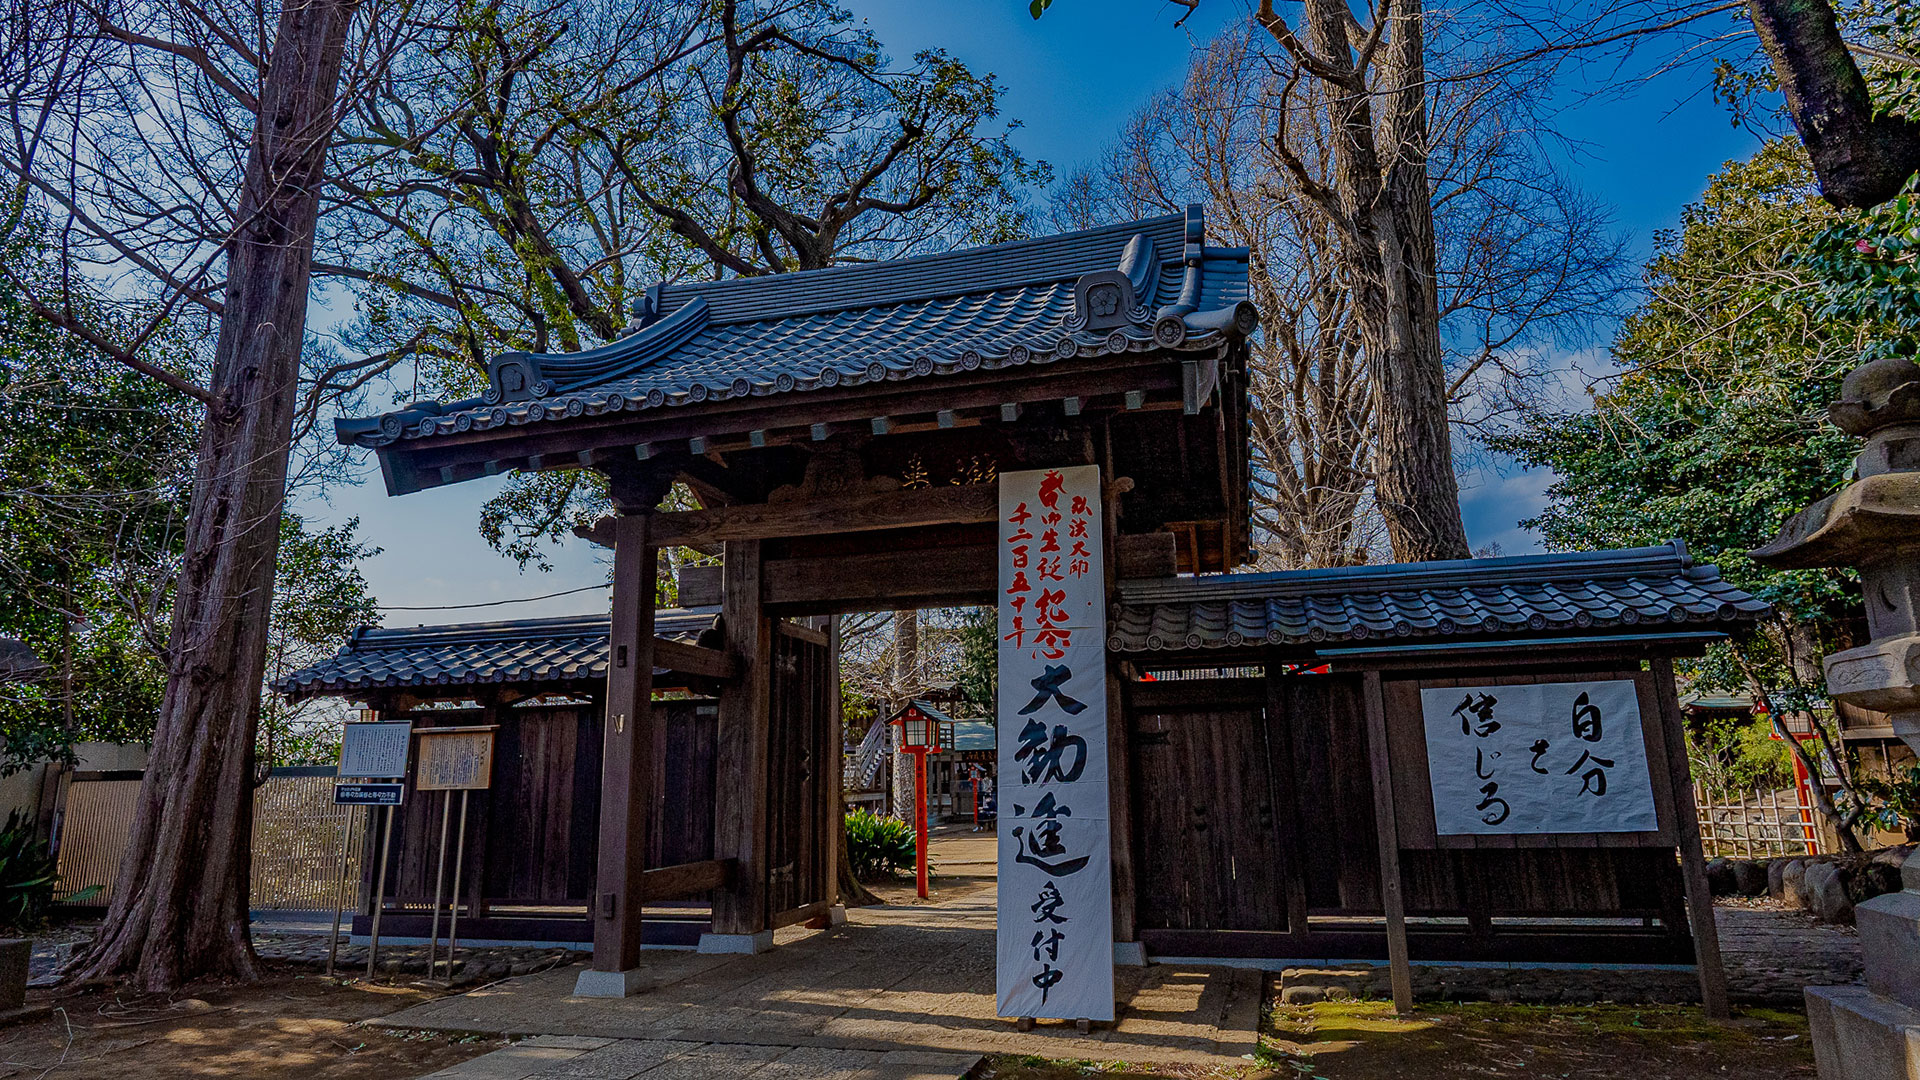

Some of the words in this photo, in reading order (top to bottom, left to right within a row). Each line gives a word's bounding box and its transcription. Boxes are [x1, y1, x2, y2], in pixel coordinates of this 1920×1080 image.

[1003, 502, 1033, 650] 千二百五十年
[1451, 691, 1510, 826] 信じる
[1564, 691, 1615, 798] 自分
